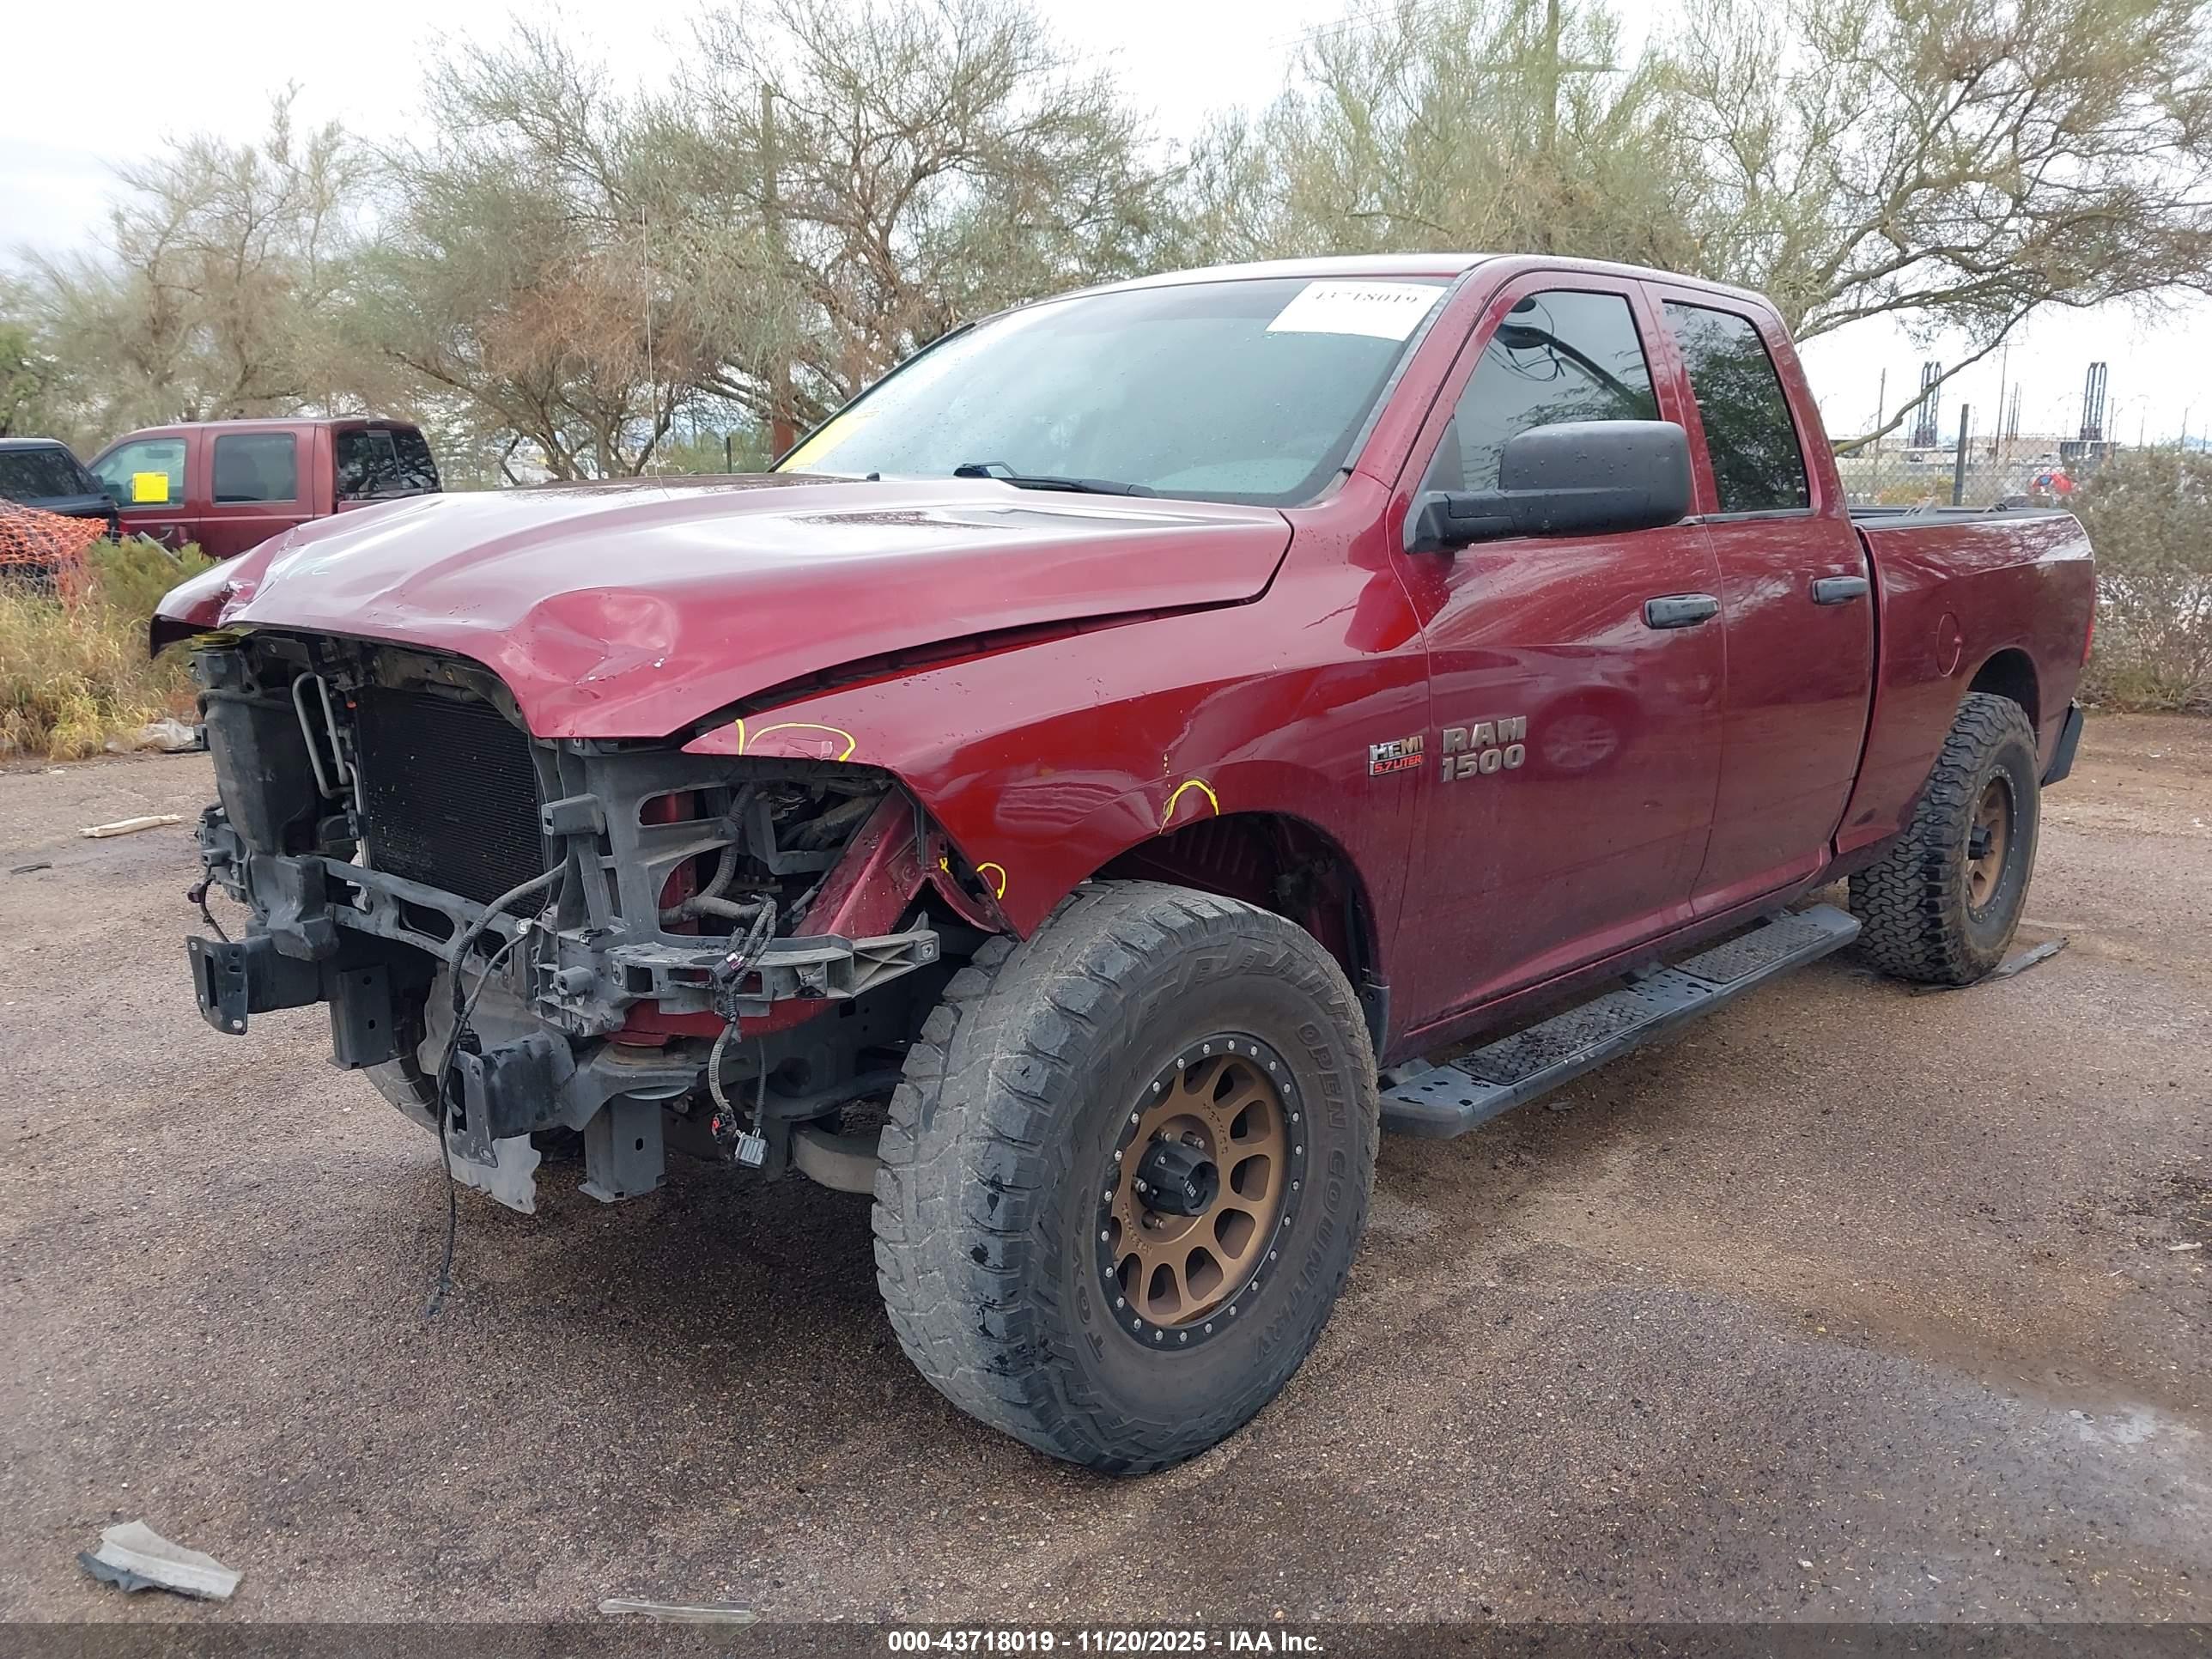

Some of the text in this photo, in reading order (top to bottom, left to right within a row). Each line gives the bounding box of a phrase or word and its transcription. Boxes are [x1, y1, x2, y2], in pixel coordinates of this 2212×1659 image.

[1370, 736, 1424, 761] HEMI
[1443, 715, 1527, 754] RAM
[1374, 755, 1423, 774] 5.7 LITER
[1442, 744, 1526, 782] 1500
[1296, 1022, 1347, 1130] OPEN
